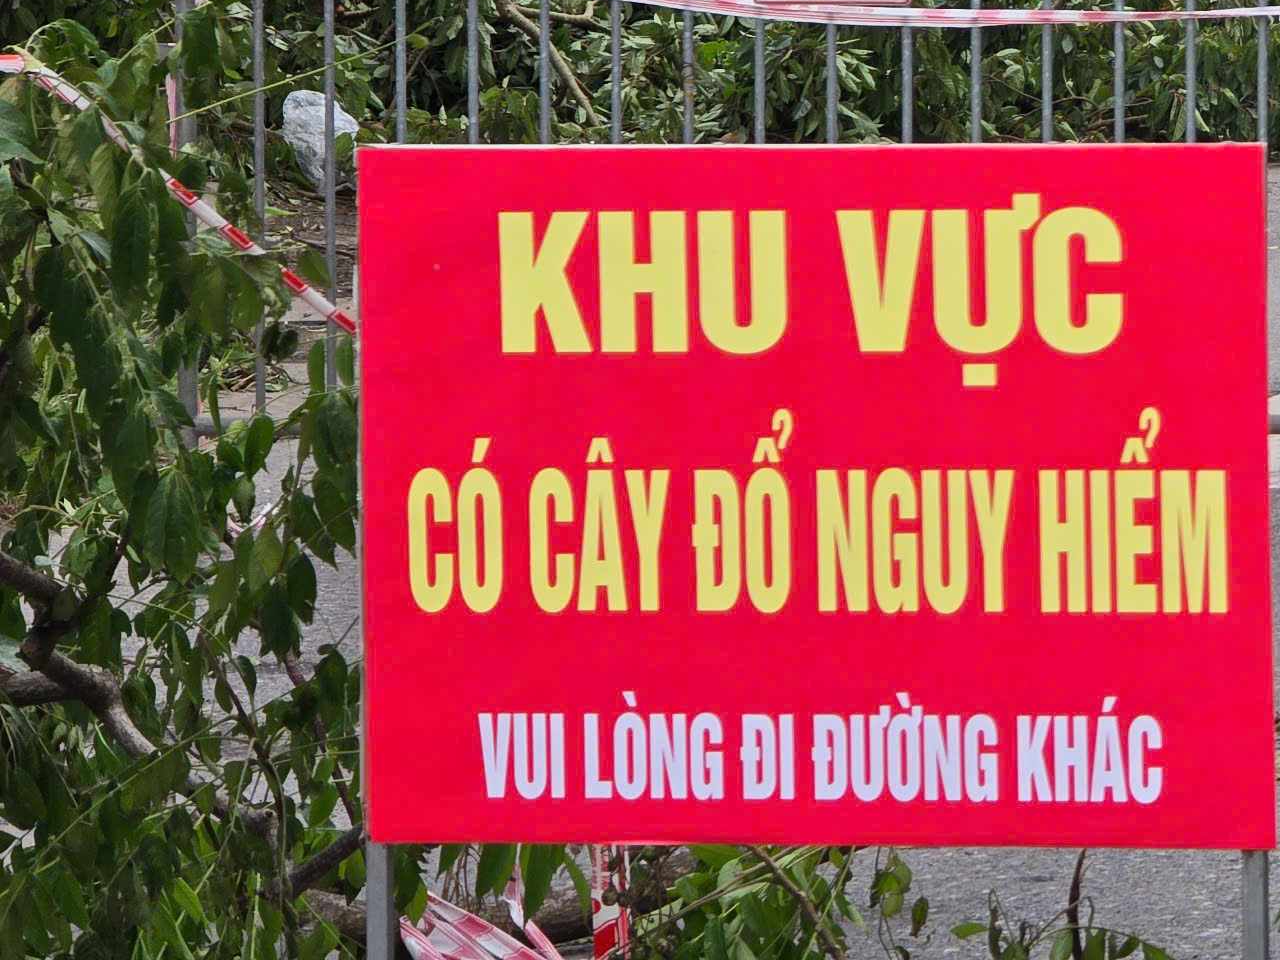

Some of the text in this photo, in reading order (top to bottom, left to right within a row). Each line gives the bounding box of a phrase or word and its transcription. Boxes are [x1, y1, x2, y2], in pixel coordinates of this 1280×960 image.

[498, 192, 1124, 387] KHU VỰC
[407, 406, 1229, 615] CÓ CÂY ĐỔ NGUY HIỂM
[477, 690, 1163, 805] VUI LÒNG ĐI ĐƯỜNG KHÁC
